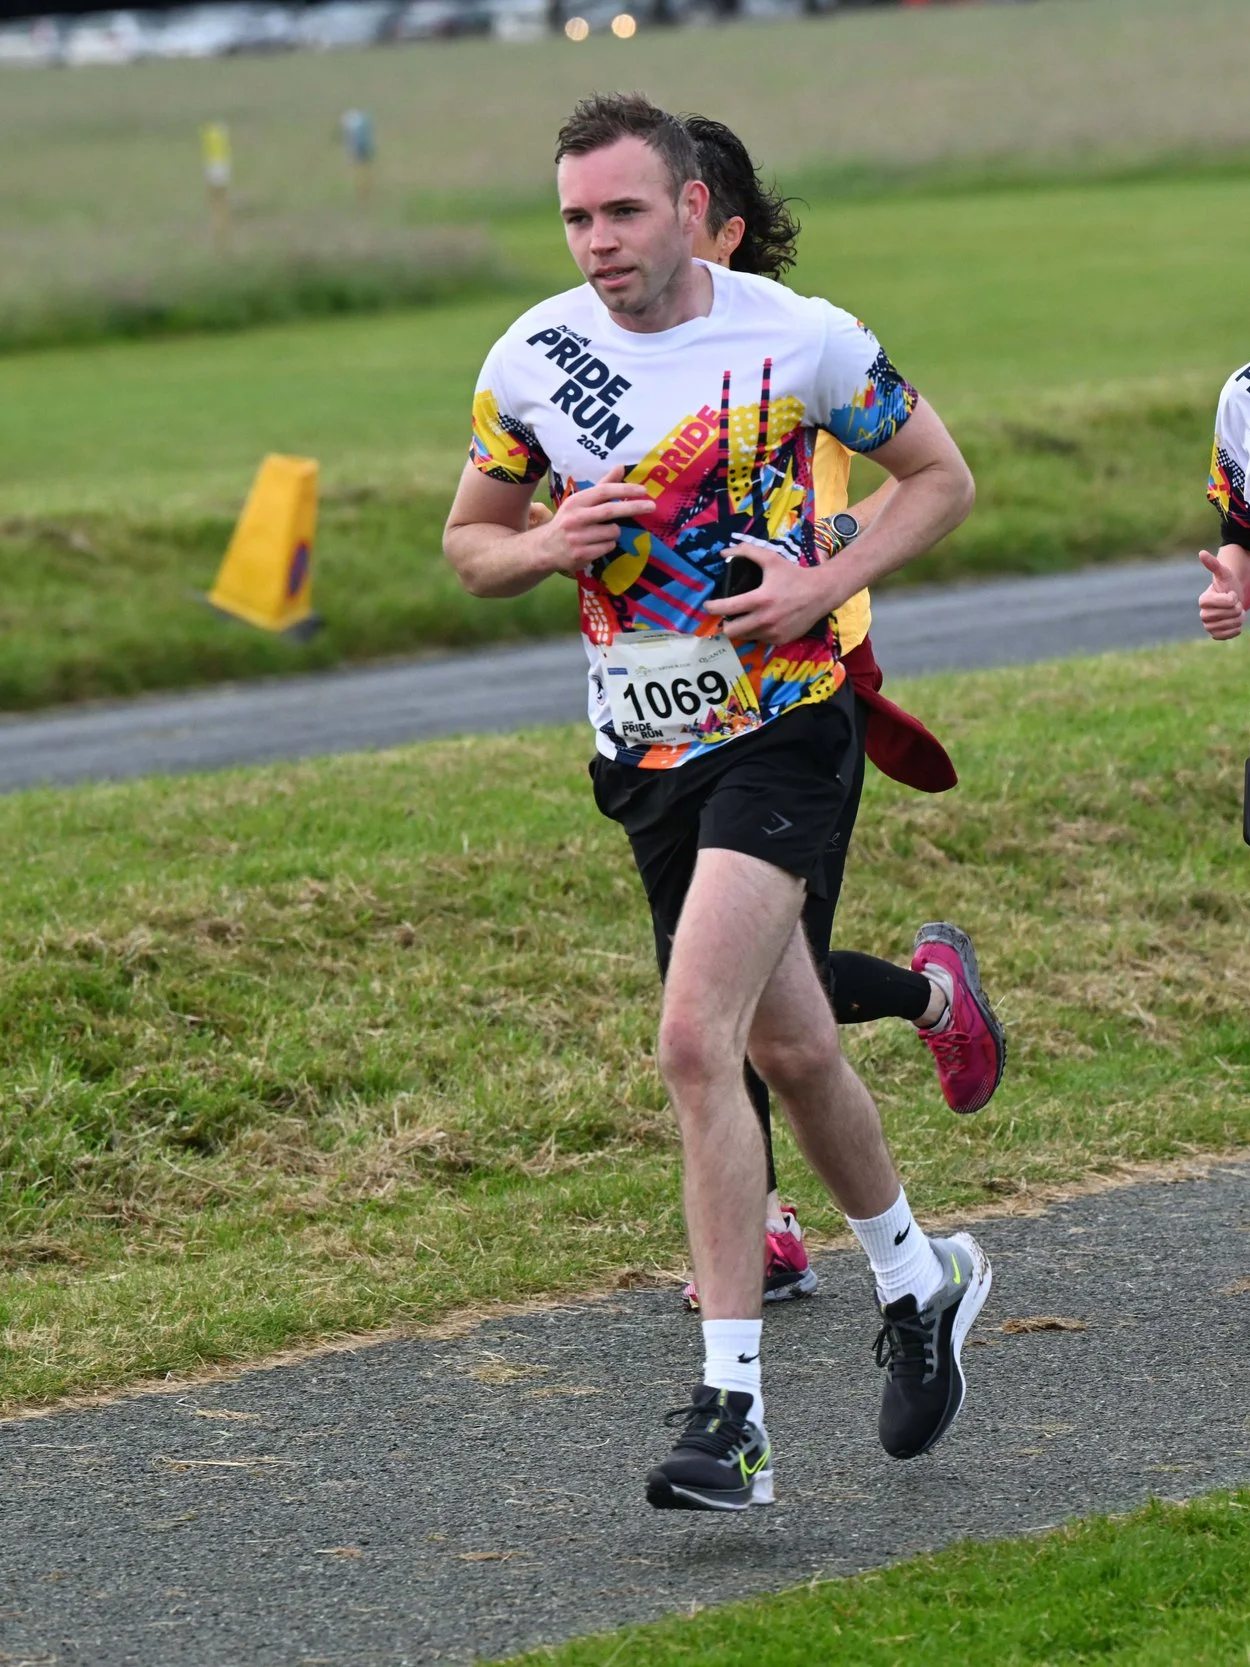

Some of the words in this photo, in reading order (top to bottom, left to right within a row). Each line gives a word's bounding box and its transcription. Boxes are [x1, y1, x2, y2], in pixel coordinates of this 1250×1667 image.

[526, 328, 632, 407] PRIDE
[549, 378, 634, 450] RUN
[576, 433, 609, 461] 2024
[639, 404, 721, 488] PRIDE
[623, 670, 729, 721] 1069
[622, 722, 653, 734] PRIDE
[640, 729, 664, 740] RUN
